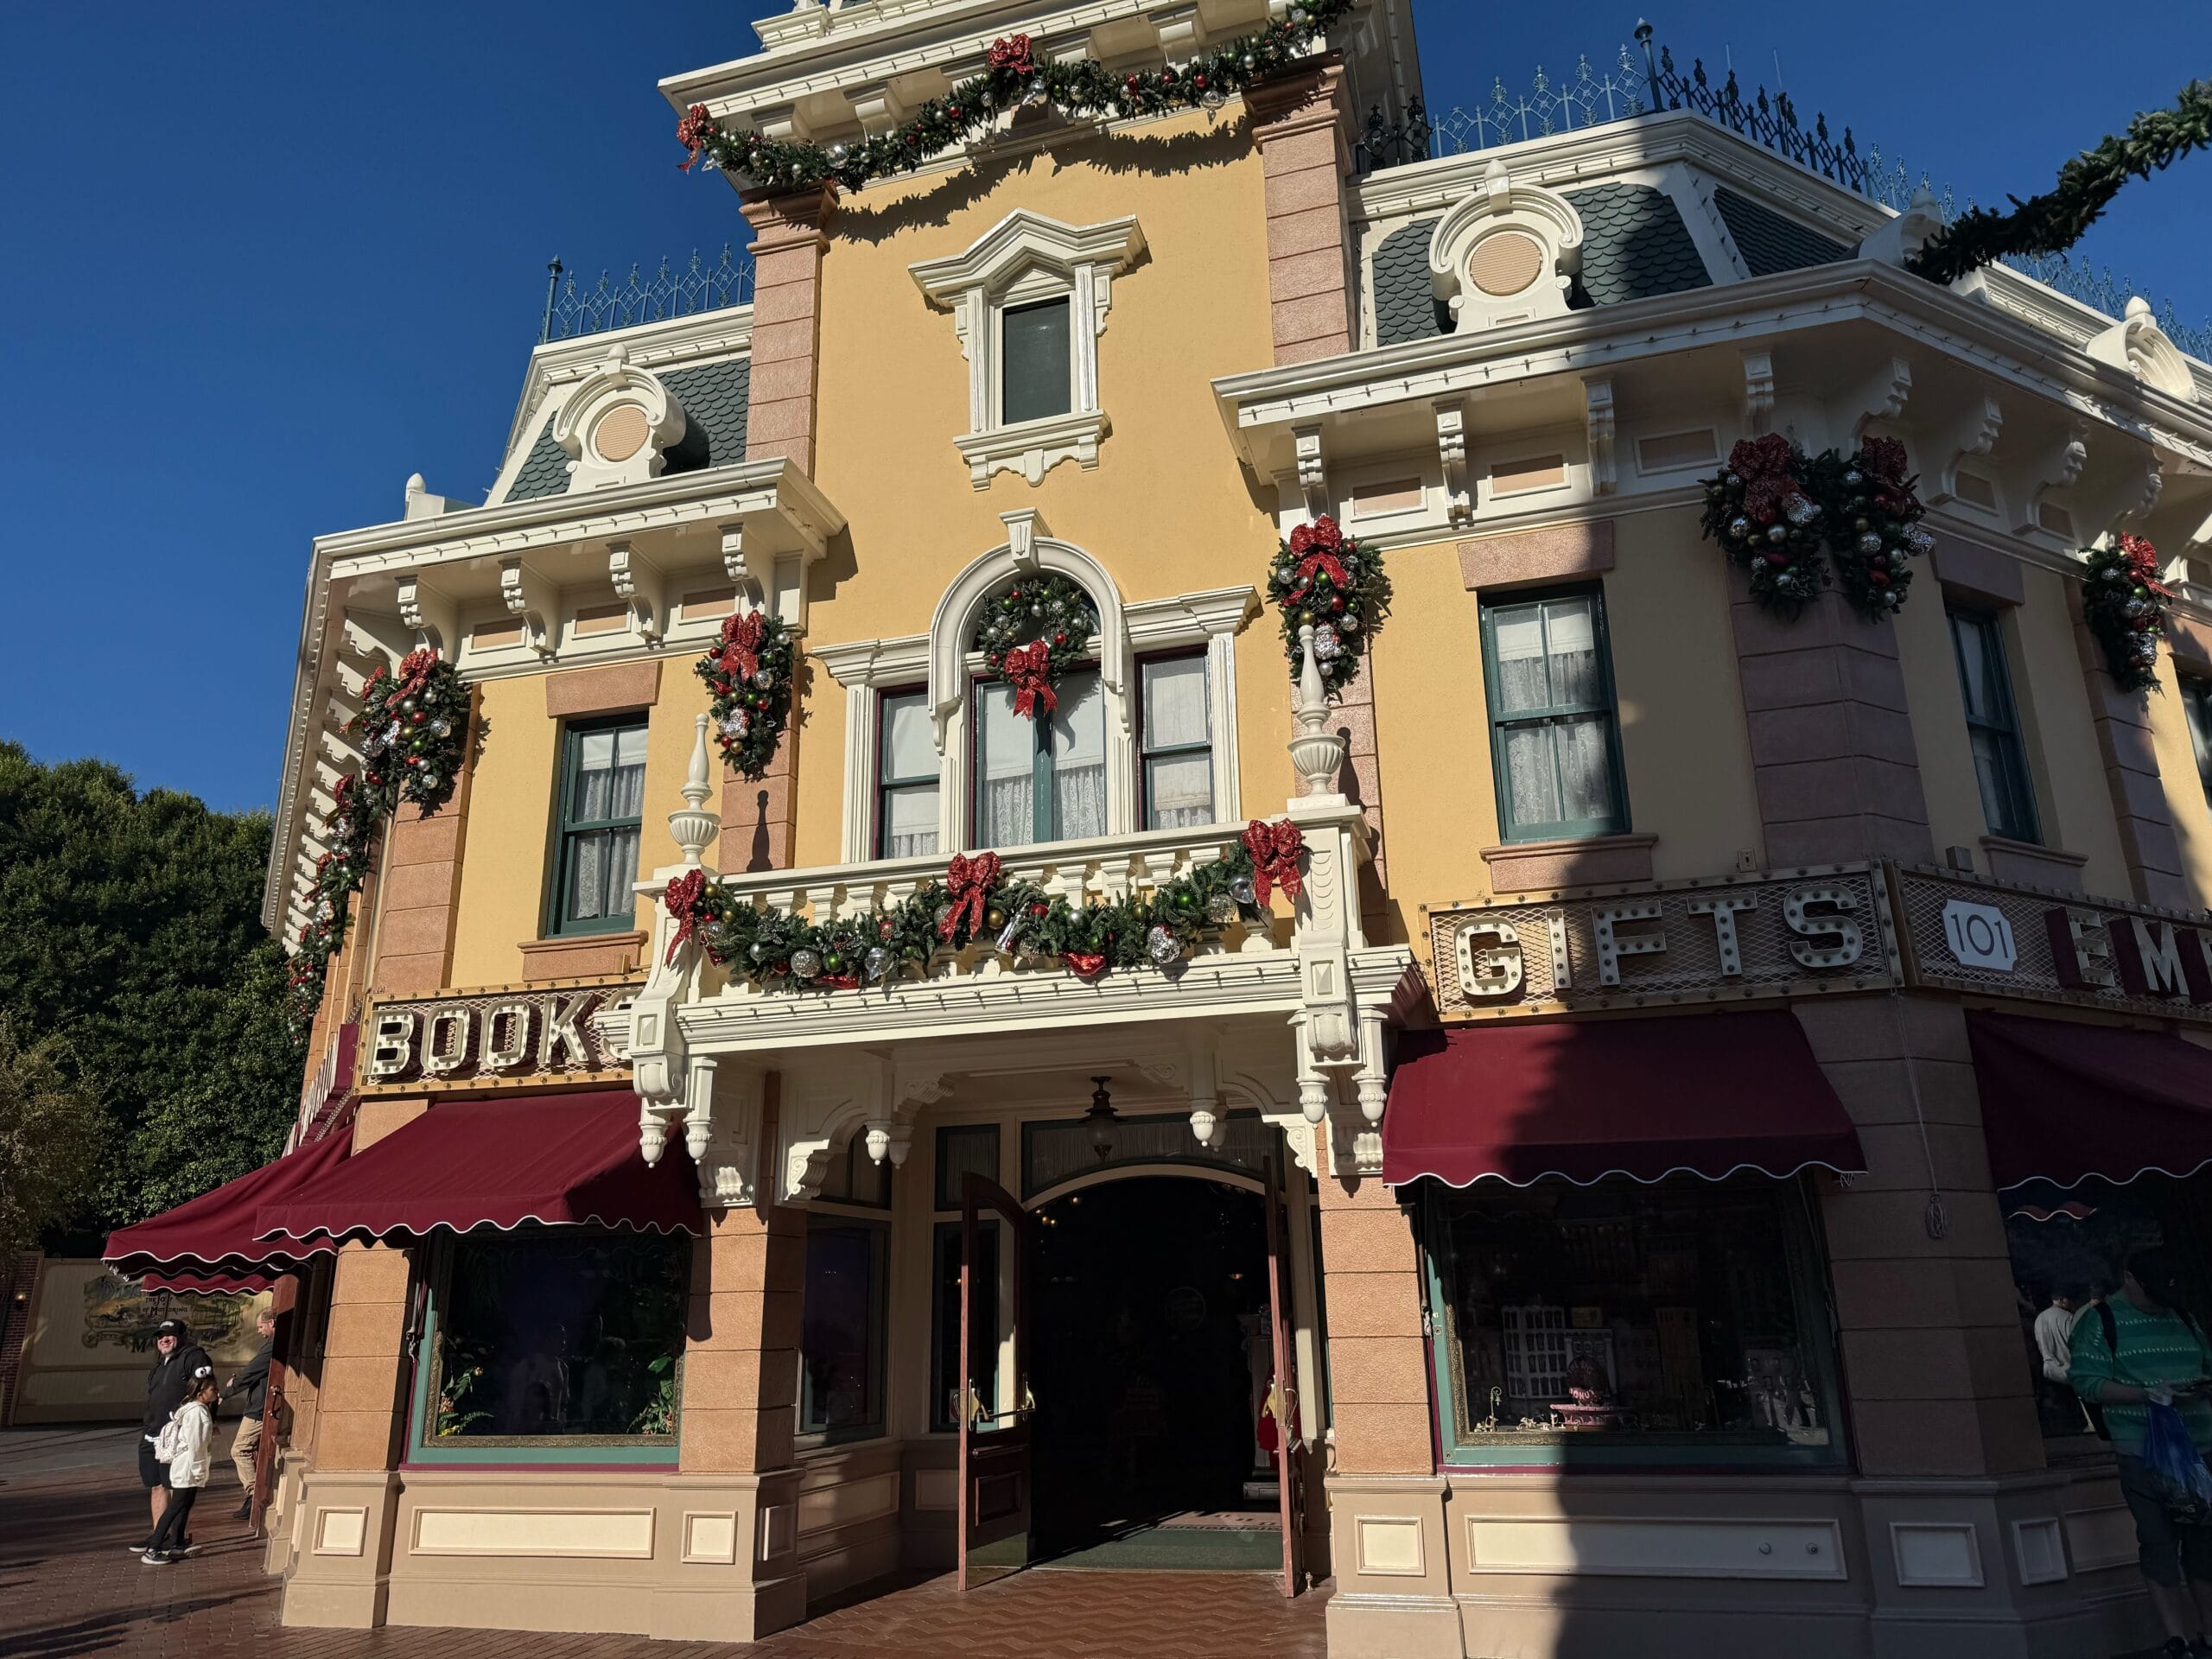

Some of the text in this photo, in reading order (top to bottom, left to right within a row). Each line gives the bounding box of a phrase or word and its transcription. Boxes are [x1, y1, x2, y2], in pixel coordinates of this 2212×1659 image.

[1453, 883, 1864, 996] GIFTS
[1950, 912, 2009, 959] 101
[2045, 907, 2212, 998] EM
